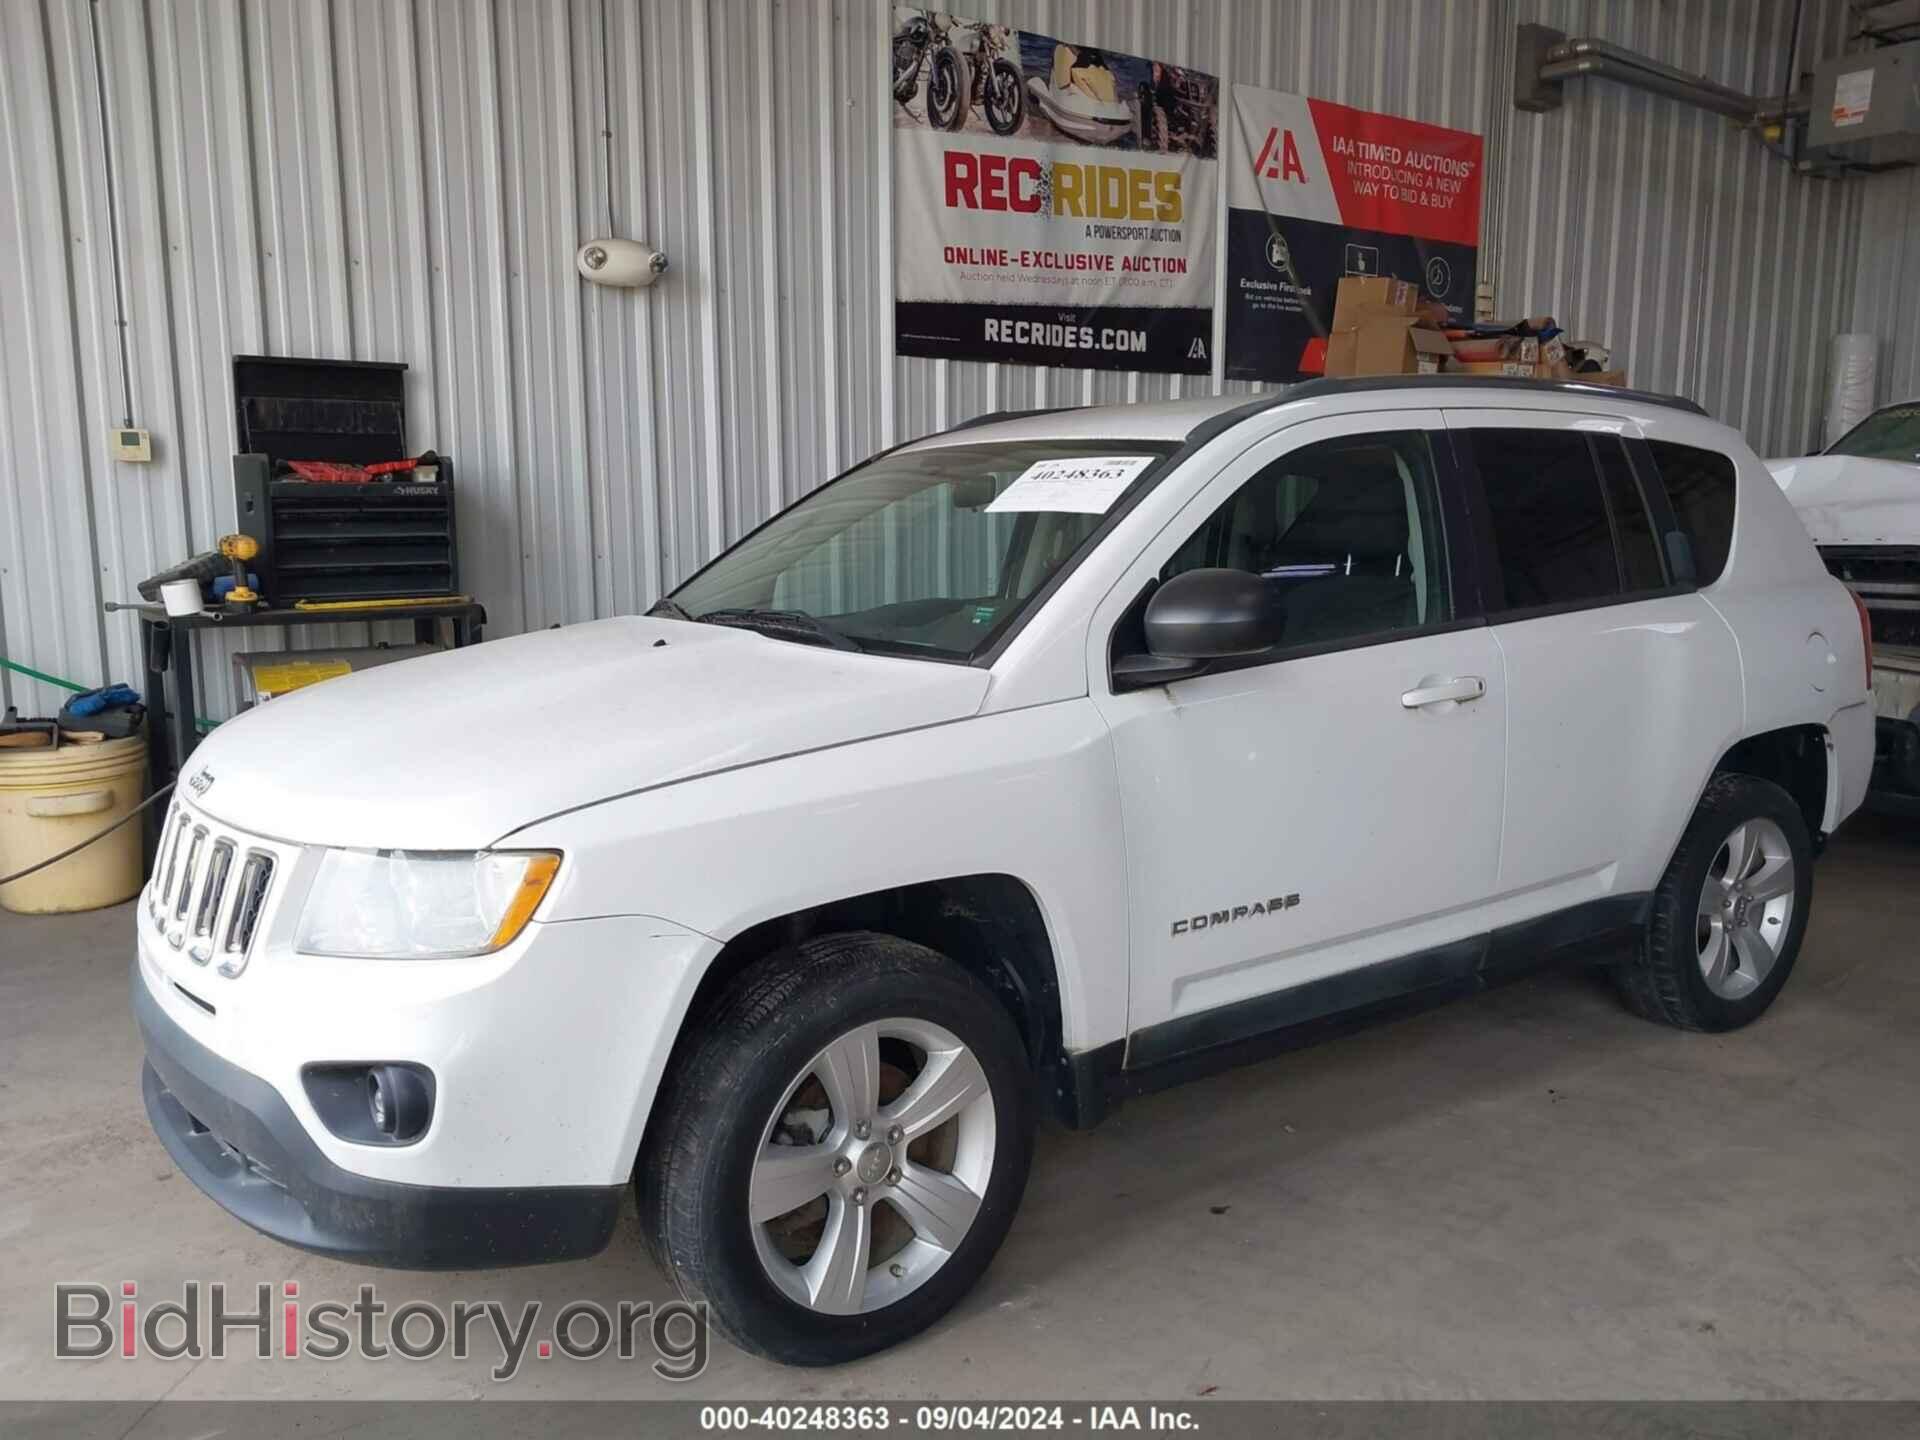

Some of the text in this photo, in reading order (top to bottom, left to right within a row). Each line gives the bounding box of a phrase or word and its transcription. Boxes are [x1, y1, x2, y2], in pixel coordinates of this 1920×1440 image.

[1333, 135, 1355, 157] IAA
[1356, 142, 1400, 165] TIMED
[1347, 160, 1461, 193] INTRODUCING A NEW
[1352, 180, 1453, 208] WAY TO BID & BUY
[1085, 224, 1182, 243] A POWERSPORT AUCTION
[944, 247, 1187, 273] ONLINE-EXCLUSIVE AUCTION
[985, 318, 1147, 352] RECRIDES.COM
[1031, 468, 1125, 480] 40248363
[406, 485, 440, 496] HUSKY
[1171, 893, 1300, 936] COMPASS
